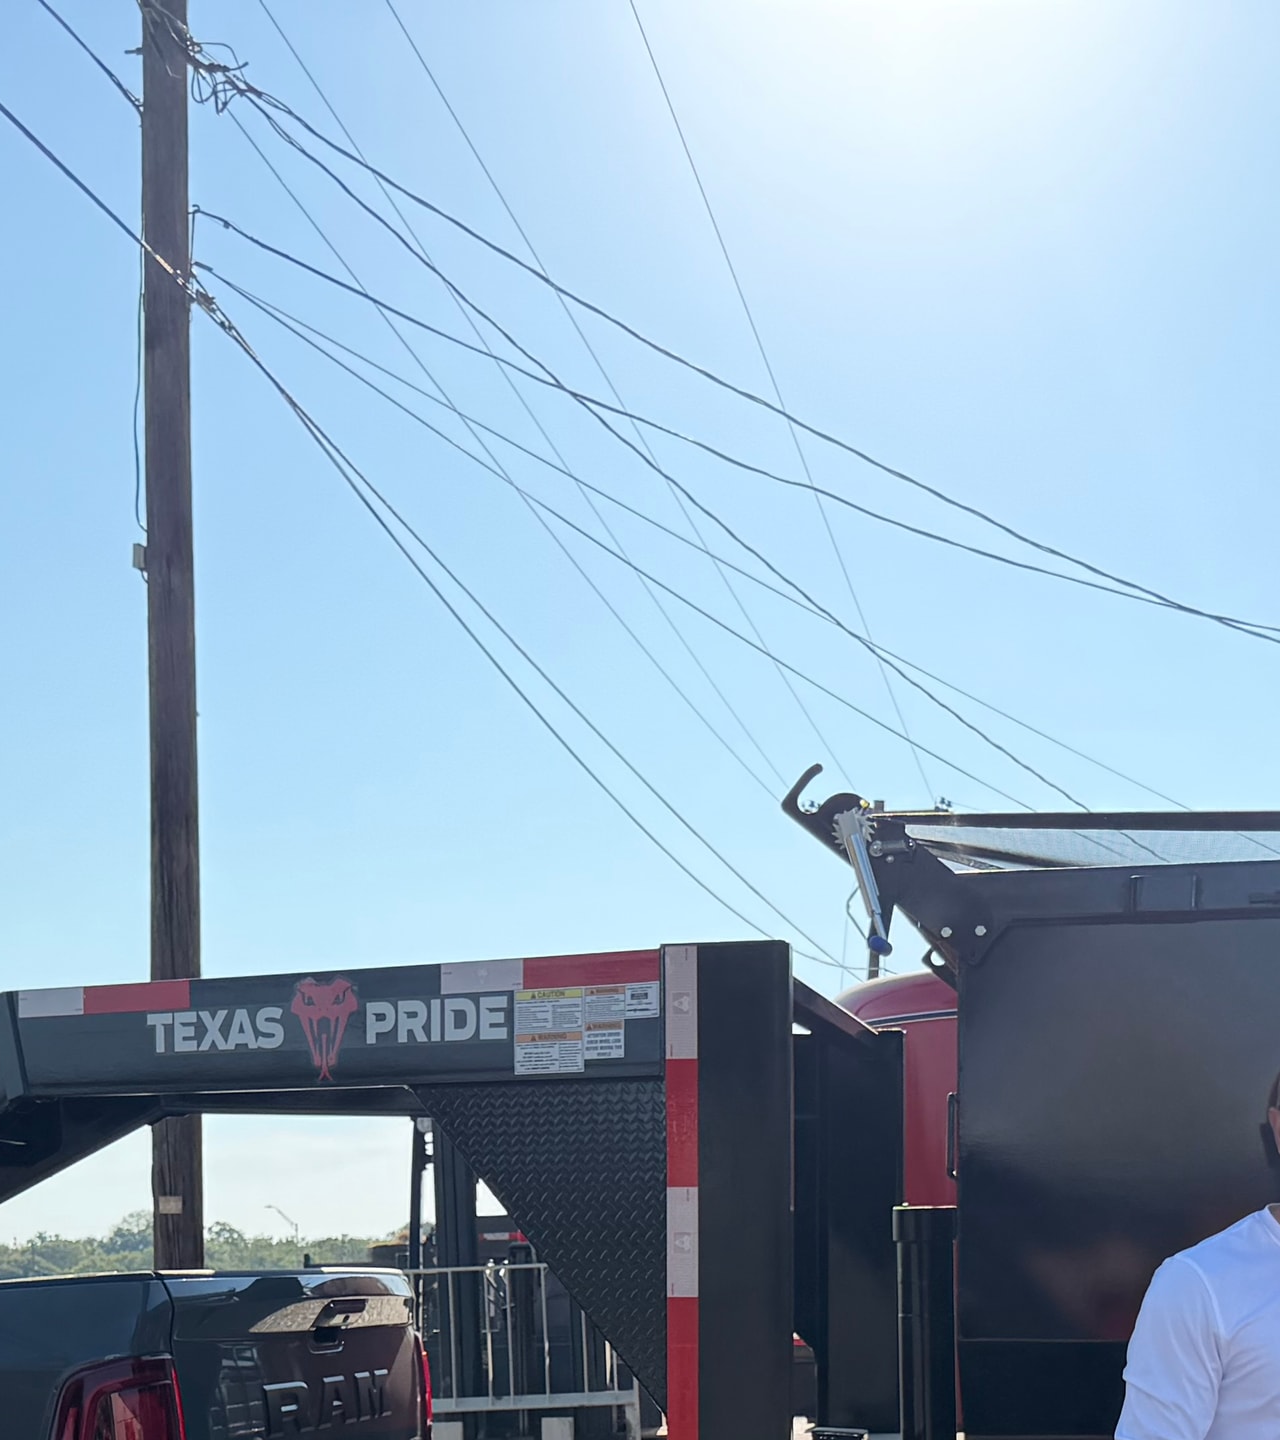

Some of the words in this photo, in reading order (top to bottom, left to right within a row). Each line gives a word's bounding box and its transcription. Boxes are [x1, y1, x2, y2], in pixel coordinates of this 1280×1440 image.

[537, 991, 565, 999] CAUTION
[147, 1007, 284, 1053] TEXAS
[366, 996, 508, 1044] PRIDE
[263, 1368, 393, 1438] RAM
